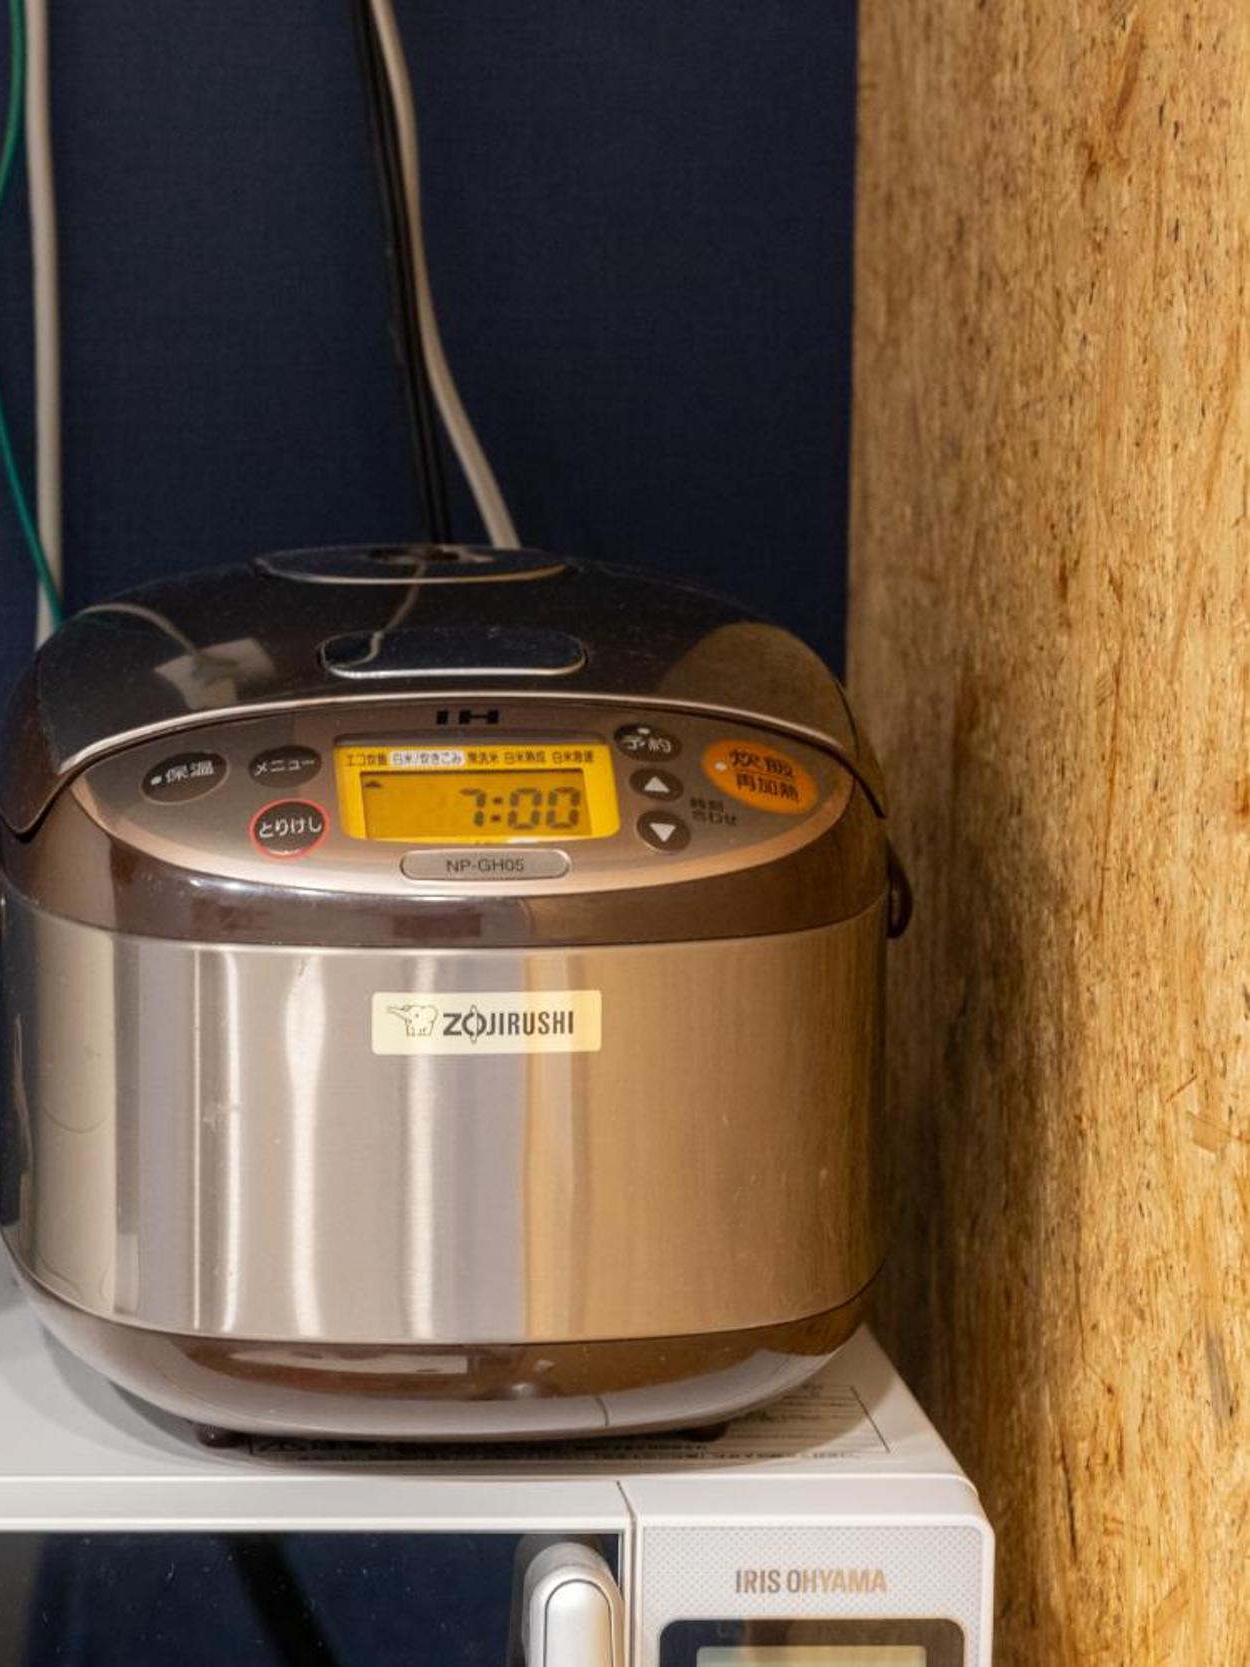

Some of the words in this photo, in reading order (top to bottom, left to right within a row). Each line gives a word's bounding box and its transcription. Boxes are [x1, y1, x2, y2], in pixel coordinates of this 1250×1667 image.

[436, 709, 499, 725] IH
[622, 734, 672, 753] 予約
[165, 760, 215, 783] 保温
[254, 758, 315, 777] メニュー
[729, 748, 796, 778] 炊飯
[736, 773, 800, 802] 再加熱
[460, 787, 582, 831] 7:00
[258, 817, 323, 839] とりけし
[446, 858, 525, 873] NP-GH05
[443, 1004, 574, 1044] ZOJIRUSHI
[735, 1569, 781, 1594] IRIS
[786, 1569, 887, 1594] OHYAMA
